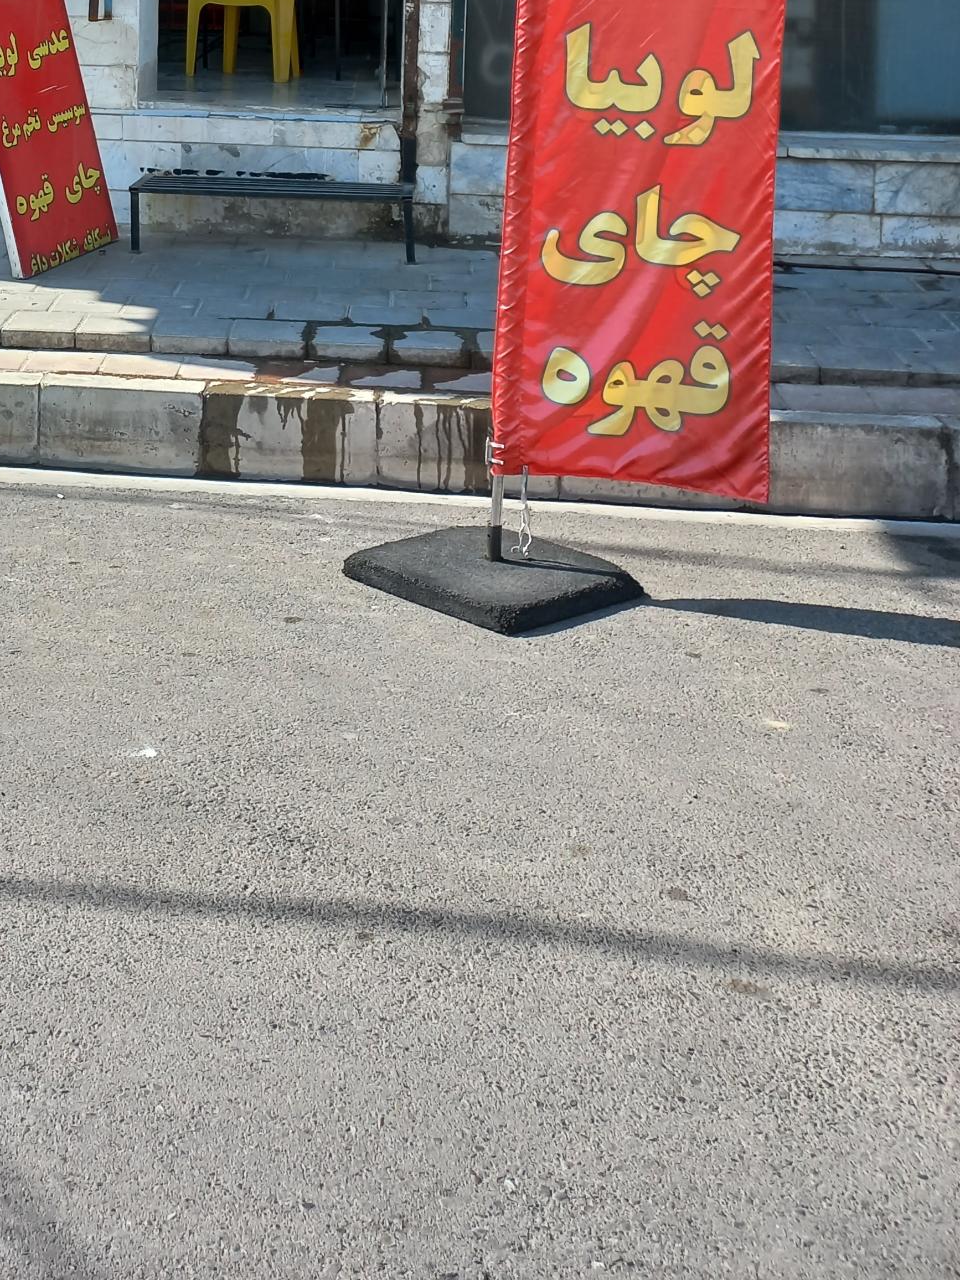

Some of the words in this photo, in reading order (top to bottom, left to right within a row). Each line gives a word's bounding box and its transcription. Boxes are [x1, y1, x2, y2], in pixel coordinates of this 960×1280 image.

[27, 28, 70, 70] عدسی
[565, 23, 761, 146] لوبیا
[46, 103, 86, 133] سوسیس
[16, 173, 54, 221] قهوه
[65, 162, 100, 205] چای
[541, 185, 741, 297] چای
[542, 320, 732, 436] قهوه
